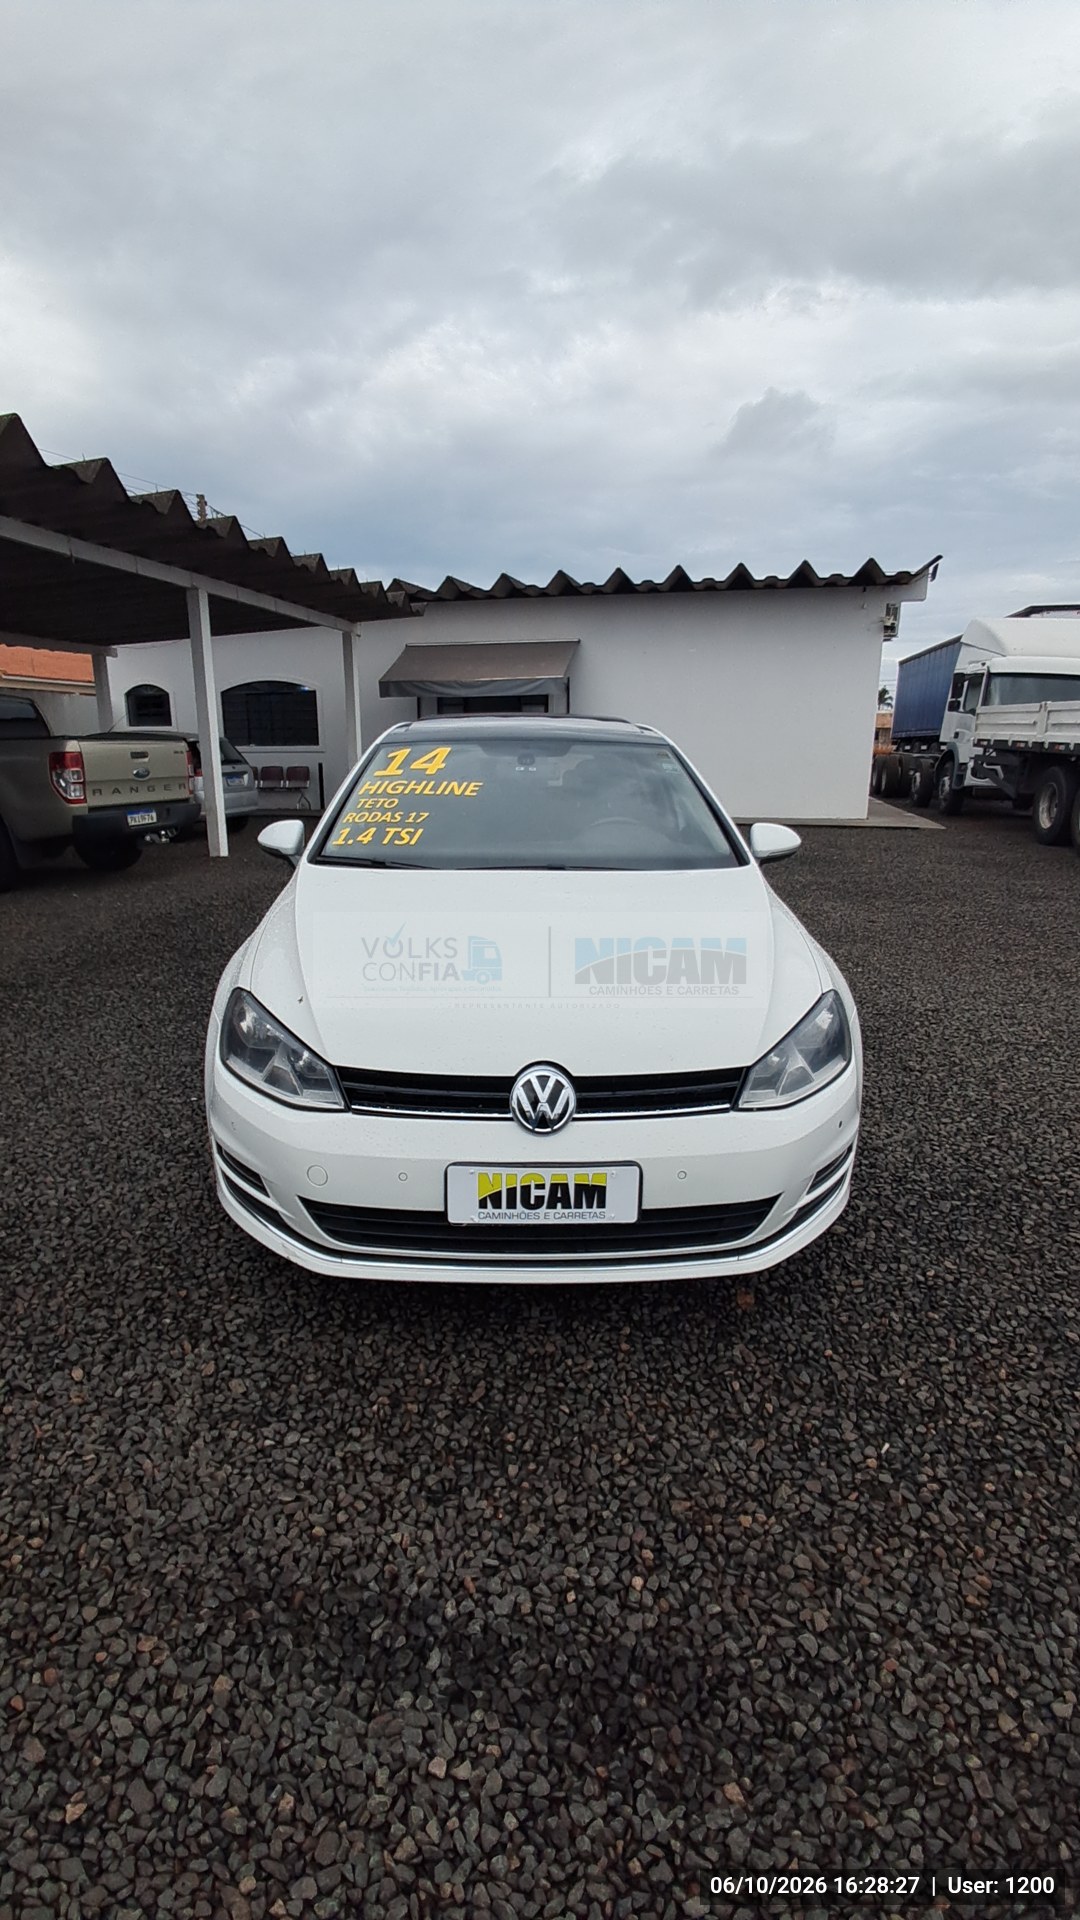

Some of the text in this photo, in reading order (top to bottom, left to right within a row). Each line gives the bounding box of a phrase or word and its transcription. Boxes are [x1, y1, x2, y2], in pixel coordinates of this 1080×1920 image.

[373, 745, 452, 777] 14
[92, 781, 187, 796] RANGER
[357, 780, 484, 797] HIGHLINE
[356, 798, 399, 809] TETO
[342, 811, 430, 824] RODAS 17
[332, 827, 424, 846] 1.4 TSI
[477, 1172, 608, 1210] NICAM
[477, 1210, 606, 1220] CAMINHÕES E CARRETAS
